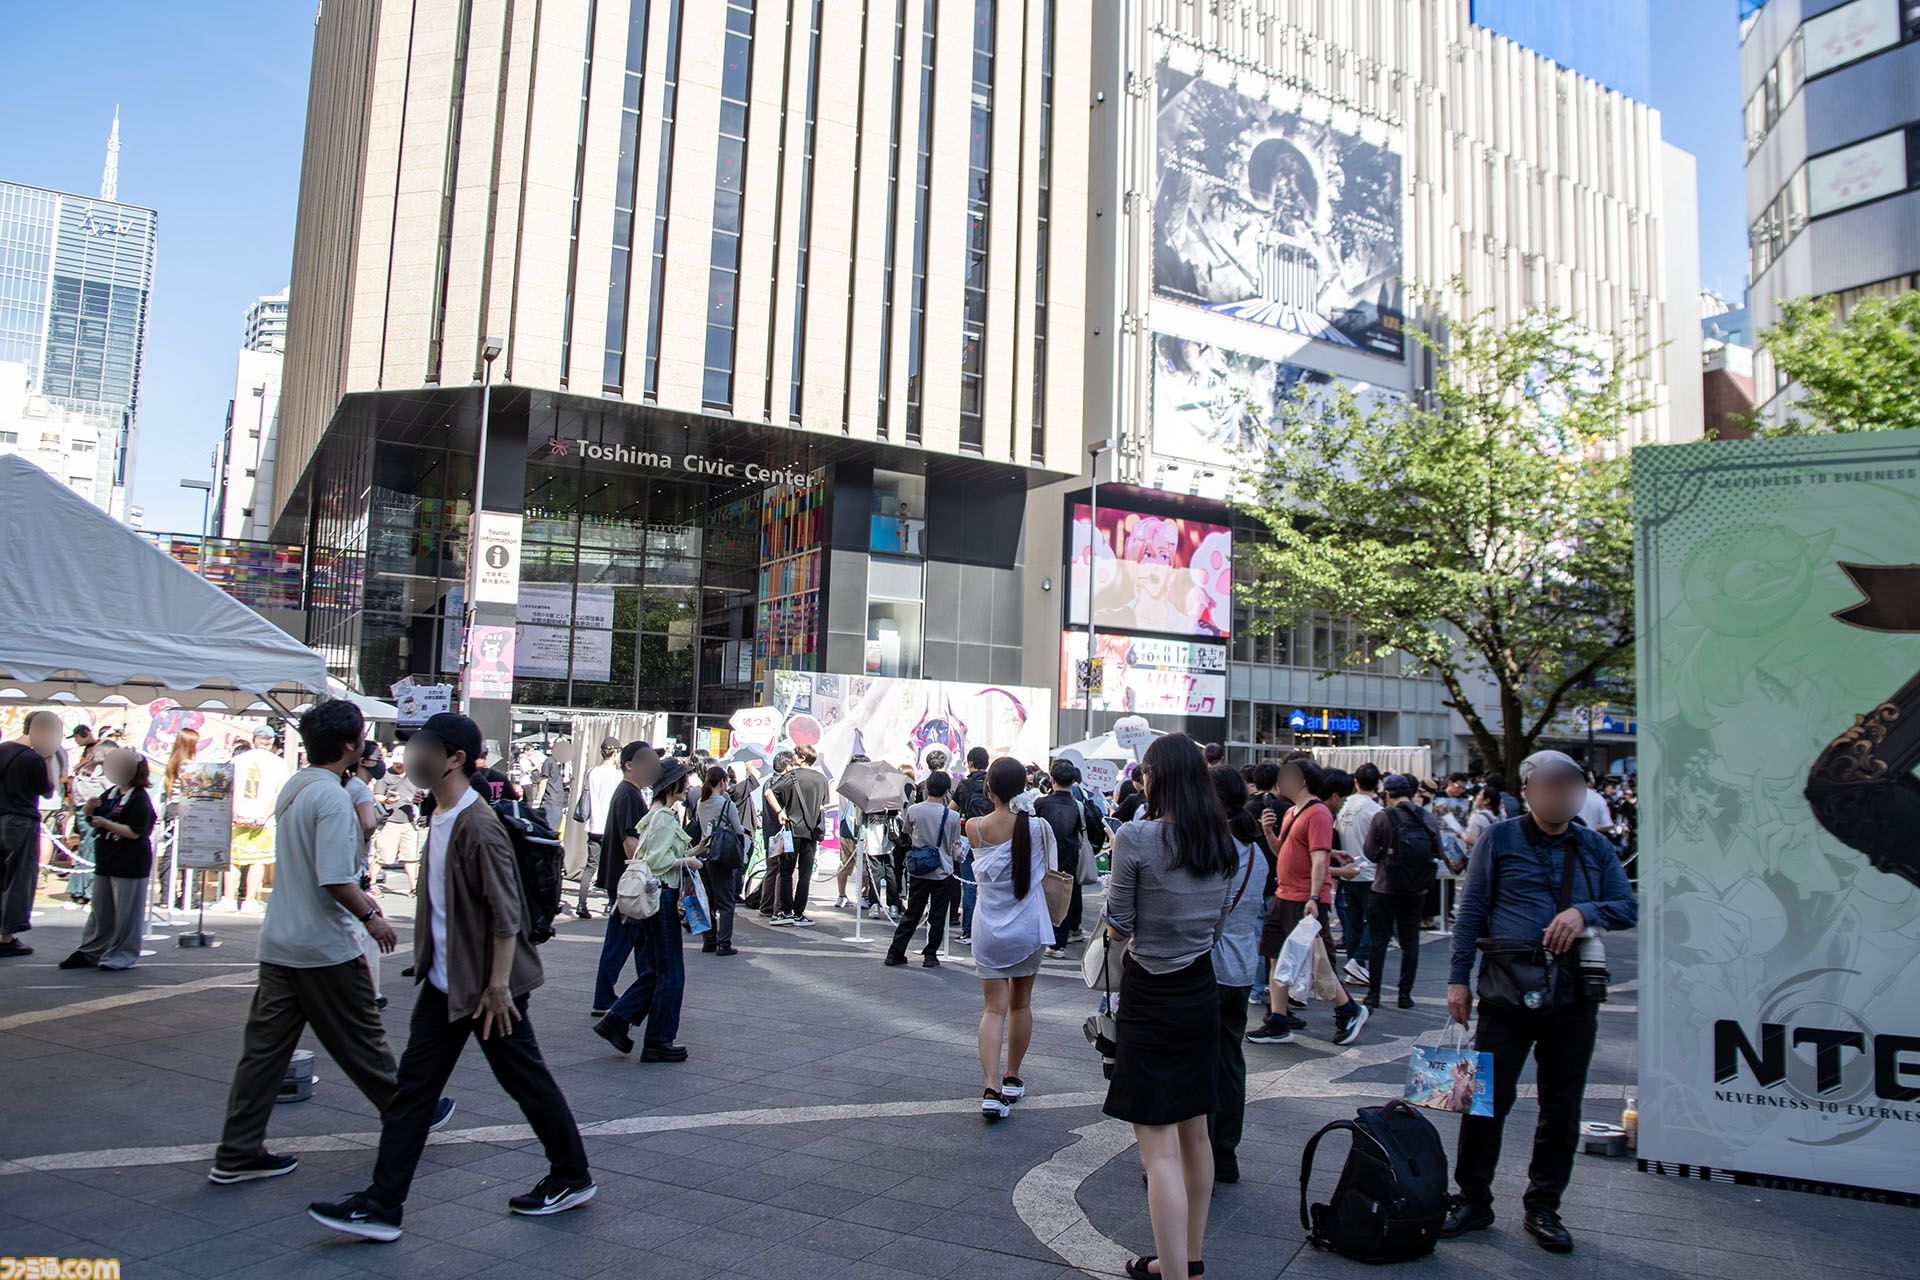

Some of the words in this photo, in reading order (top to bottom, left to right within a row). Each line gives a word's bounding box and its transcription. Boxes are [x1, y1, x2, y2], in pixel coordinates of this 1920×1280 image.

[576, 440, 672, 469] Toshima
[683, 454, 734, 477] Civic
[744, 463, 815, 488] Center
[1713, 475, 1802, 489] NEVERNESS
[1810, 473, 1827, 484] TO
[1834, 468, 1917, 483] EVERNESS
[782, 680, 811, 694] NTE
[1306, 709, 1361, 732] animate
[1428, 1060, 1447, 1071] NTE
[1714, 1019, 1920, 1103] NTE
[1715, 1090, 1809, 1110] NEVERNESS
[1818, 1101, 1840, 1114] TO
